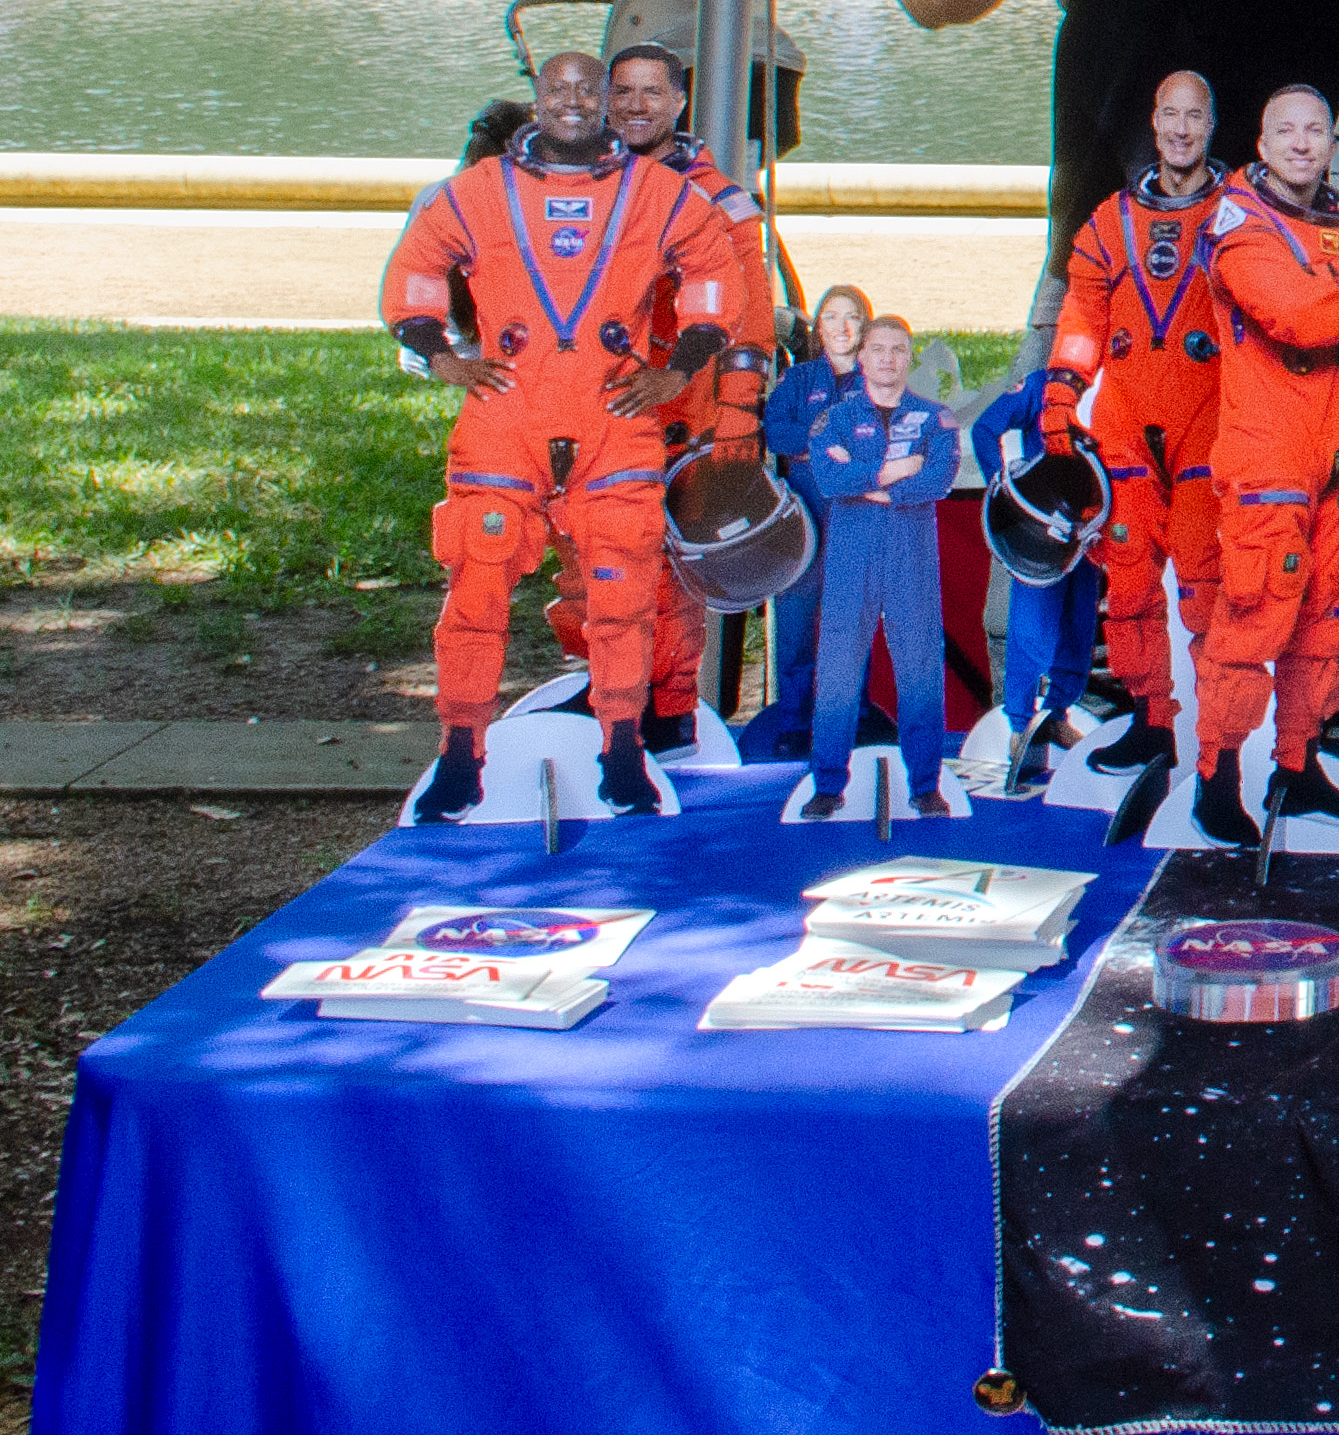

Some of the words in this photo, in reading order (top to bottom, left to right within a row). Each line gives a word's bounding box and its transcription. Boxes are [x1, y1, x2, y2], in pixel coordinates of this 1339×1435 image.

[849, 891, 981, 912] ARTEMIS
[434, 927, 583, 942] NASA
[1181, 938, 1328, 955] NASA
[314, 965, 500, 981] NASA
[807, 957, 978, 986] NASA
